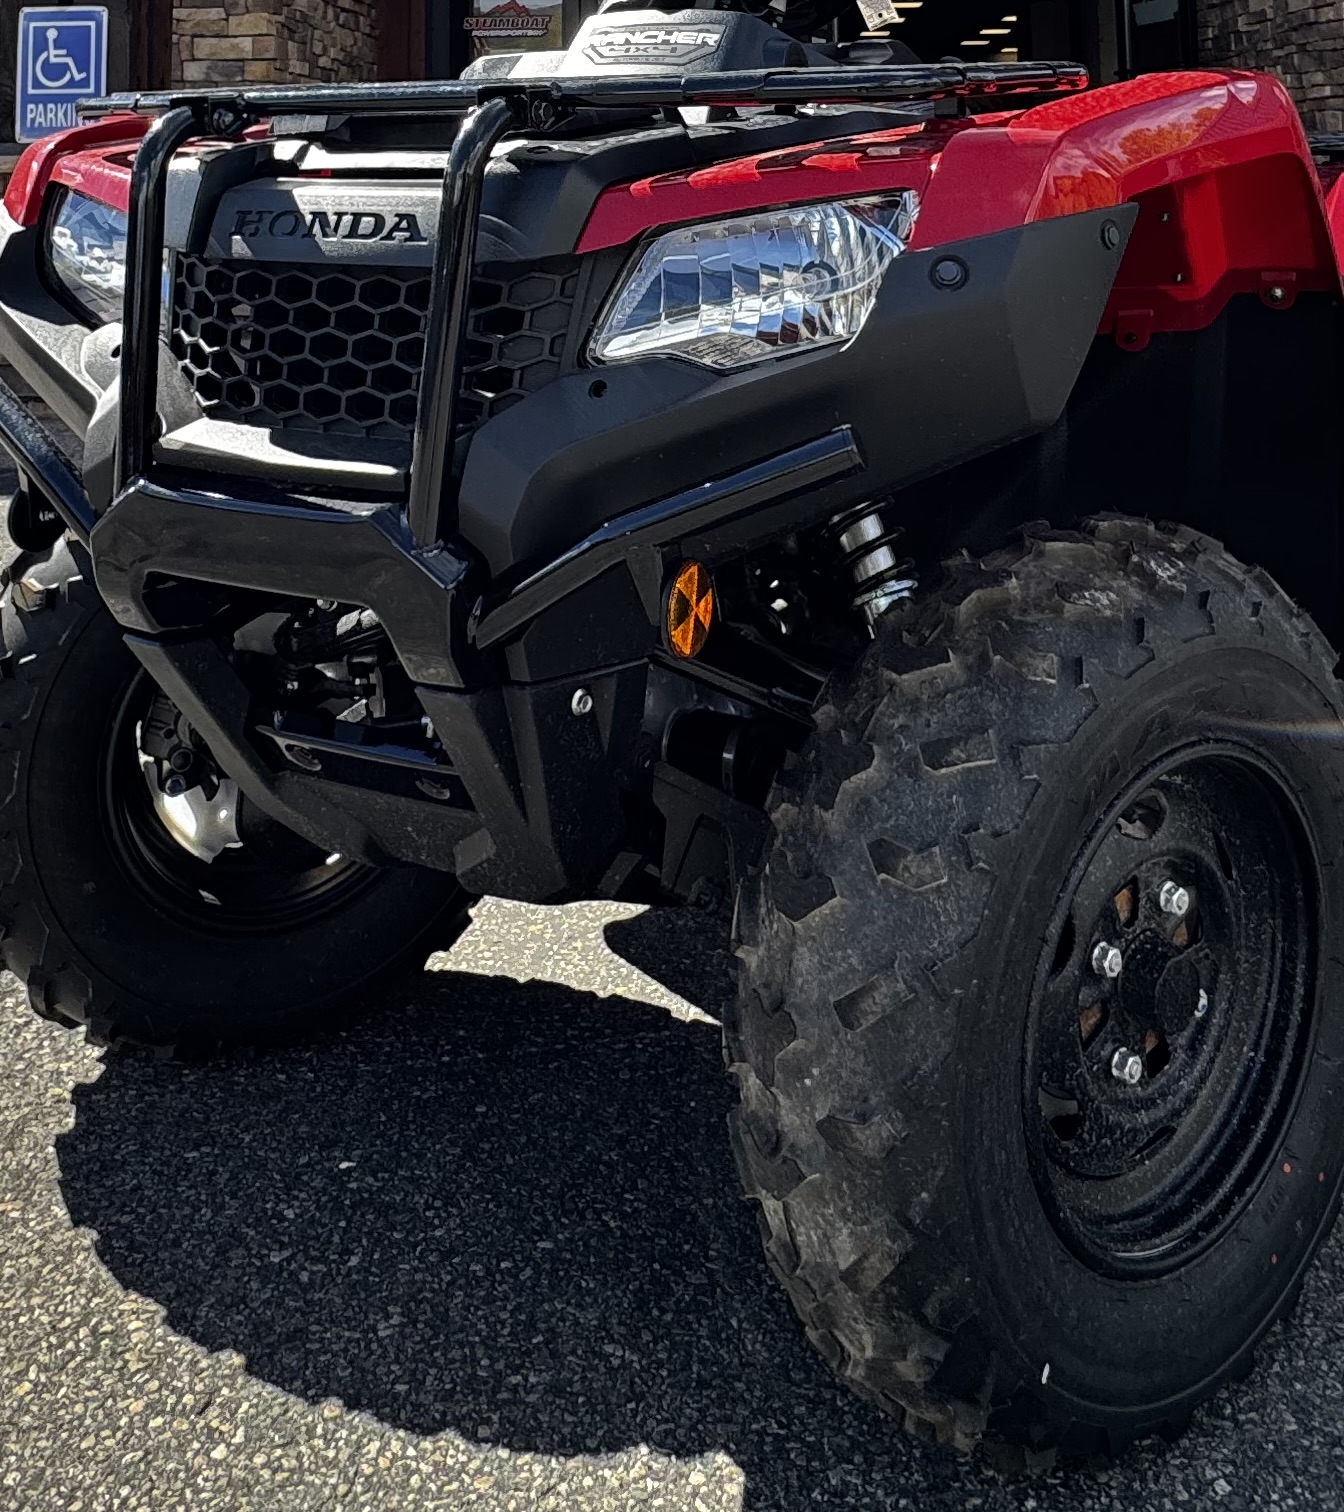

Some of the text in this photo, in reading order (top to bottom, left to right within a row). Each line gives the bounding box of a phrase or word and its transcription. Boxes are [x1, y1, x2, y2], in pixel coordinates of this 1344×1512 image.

[463, 16, 552, 30] STEAMBOAT
[26, 103, 96, 128] PARKIN
[228, 210, 426, 243] HONDA
